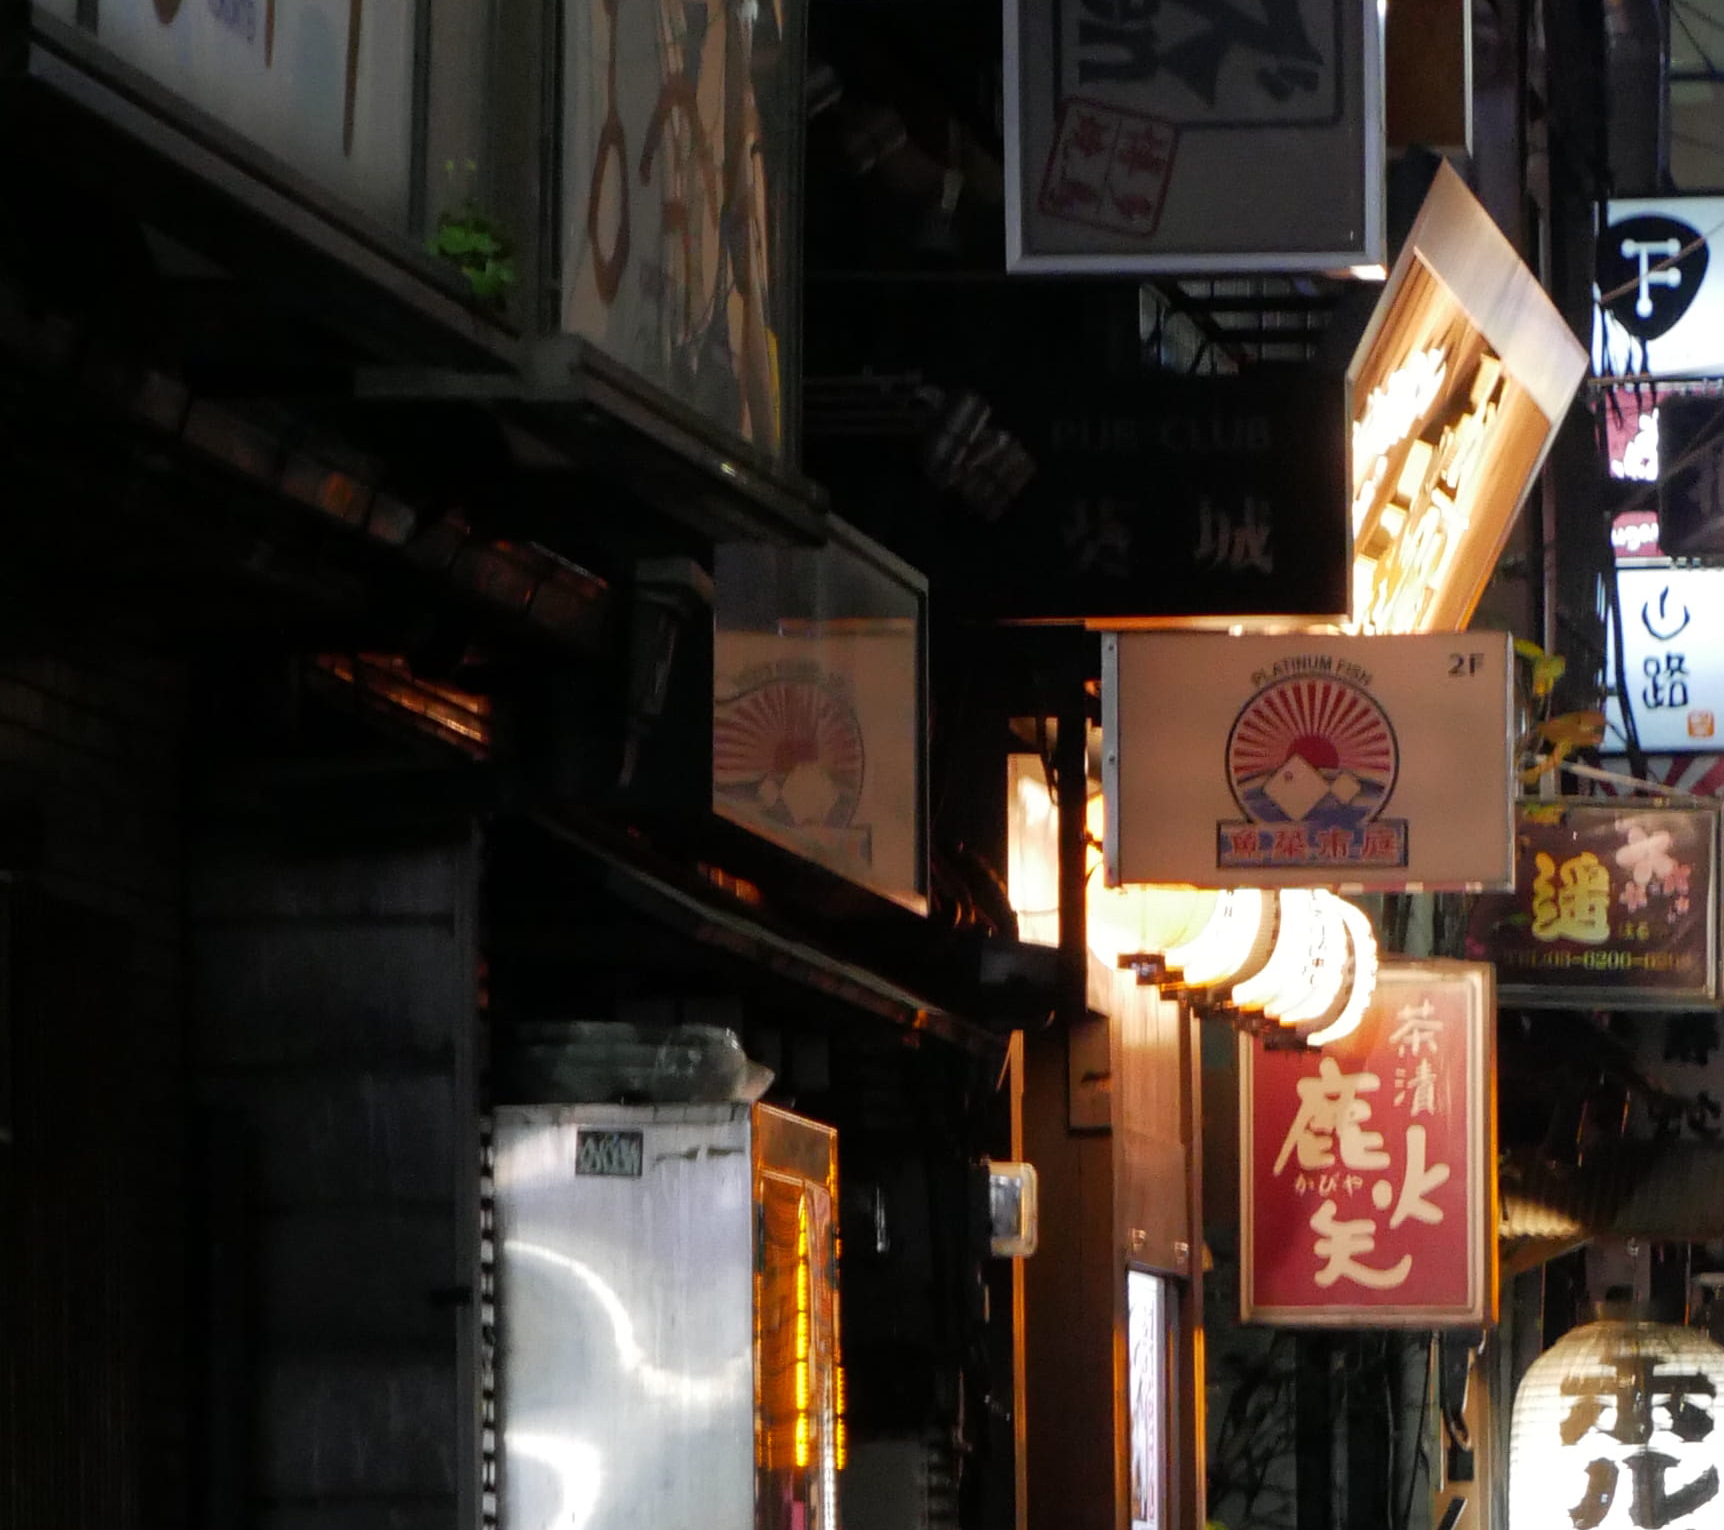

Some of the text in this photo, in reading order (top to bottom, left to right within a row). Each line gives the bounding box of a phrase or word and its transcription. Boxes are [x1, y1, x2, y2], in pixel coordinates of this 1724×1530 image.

[1250, 655, 1375, 687] PLATINUM FISH
[1448, 654, 1485, 678] 2F
[1388, 998, 1445, 1118] 茶漬
[1294, 1172, 1365, 1198] かびや
